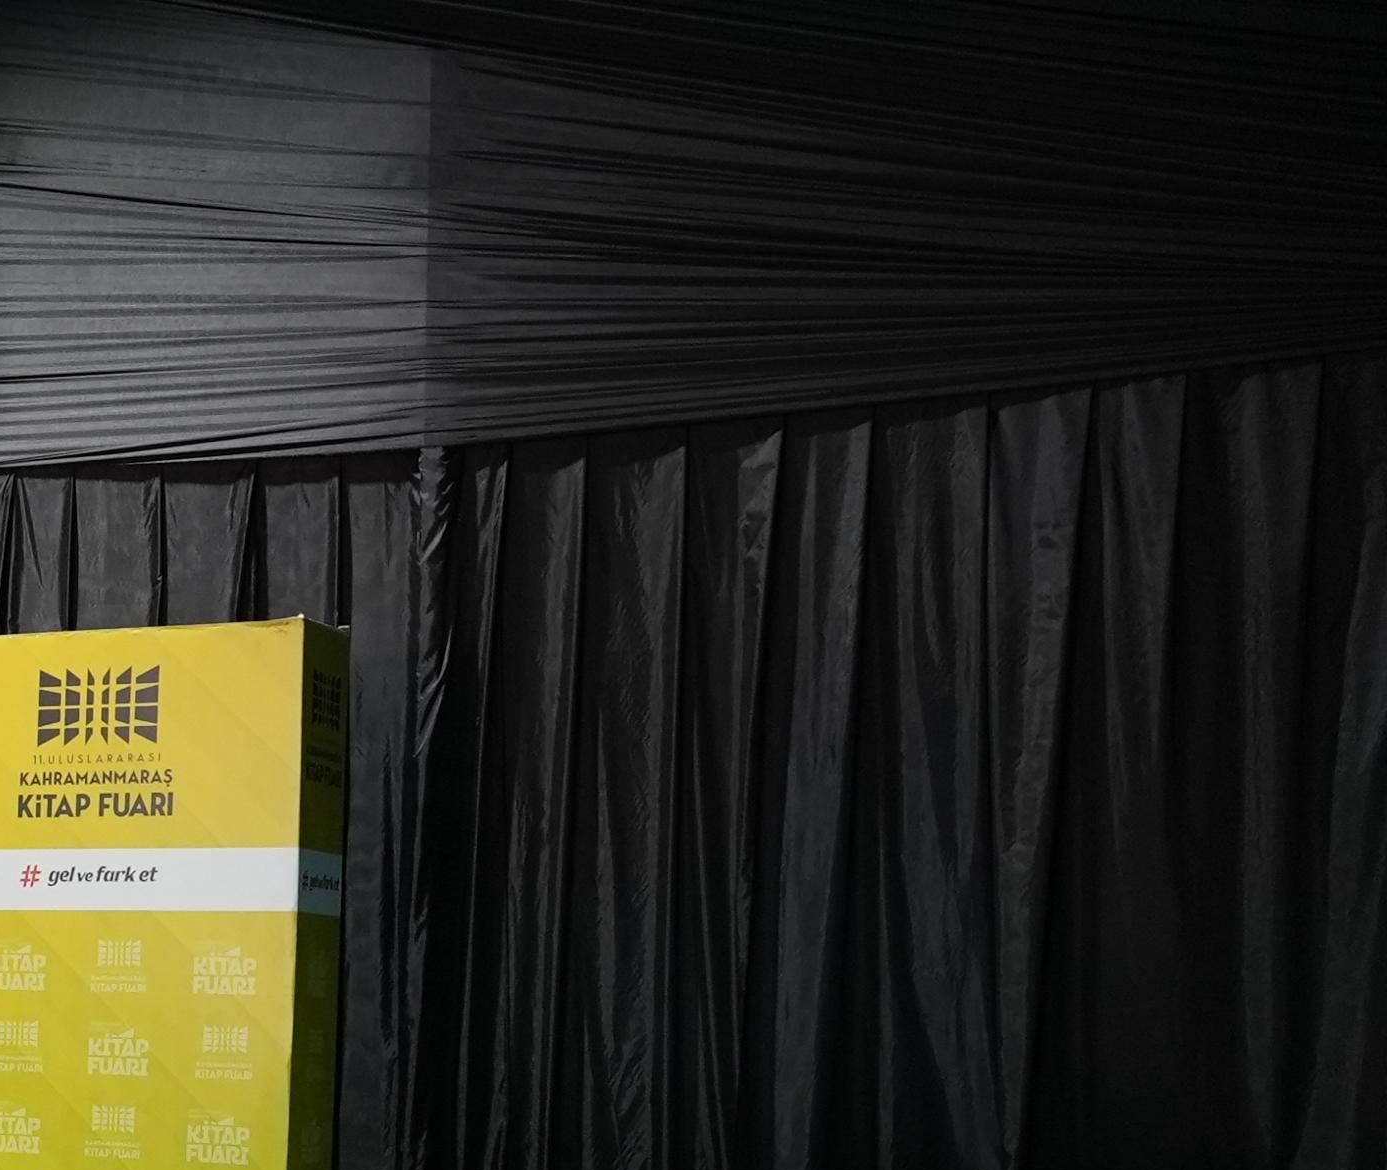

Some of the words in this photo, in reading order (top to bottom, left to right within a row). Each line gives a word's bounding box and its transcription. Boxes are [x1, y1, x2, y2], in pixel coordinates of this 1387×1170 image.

[19, 768, 173, 787] KAHRAMANMARAŞ
[98, 791, 174, 818] FUARI
[95, 865, 137, 882] fark
[139, 866, 158, 882] et
[192, 976, 257, 995] FUARI
[87, 1058, 148, 1077] FUARI
[186, 1145, 250, 1166] FUARI
